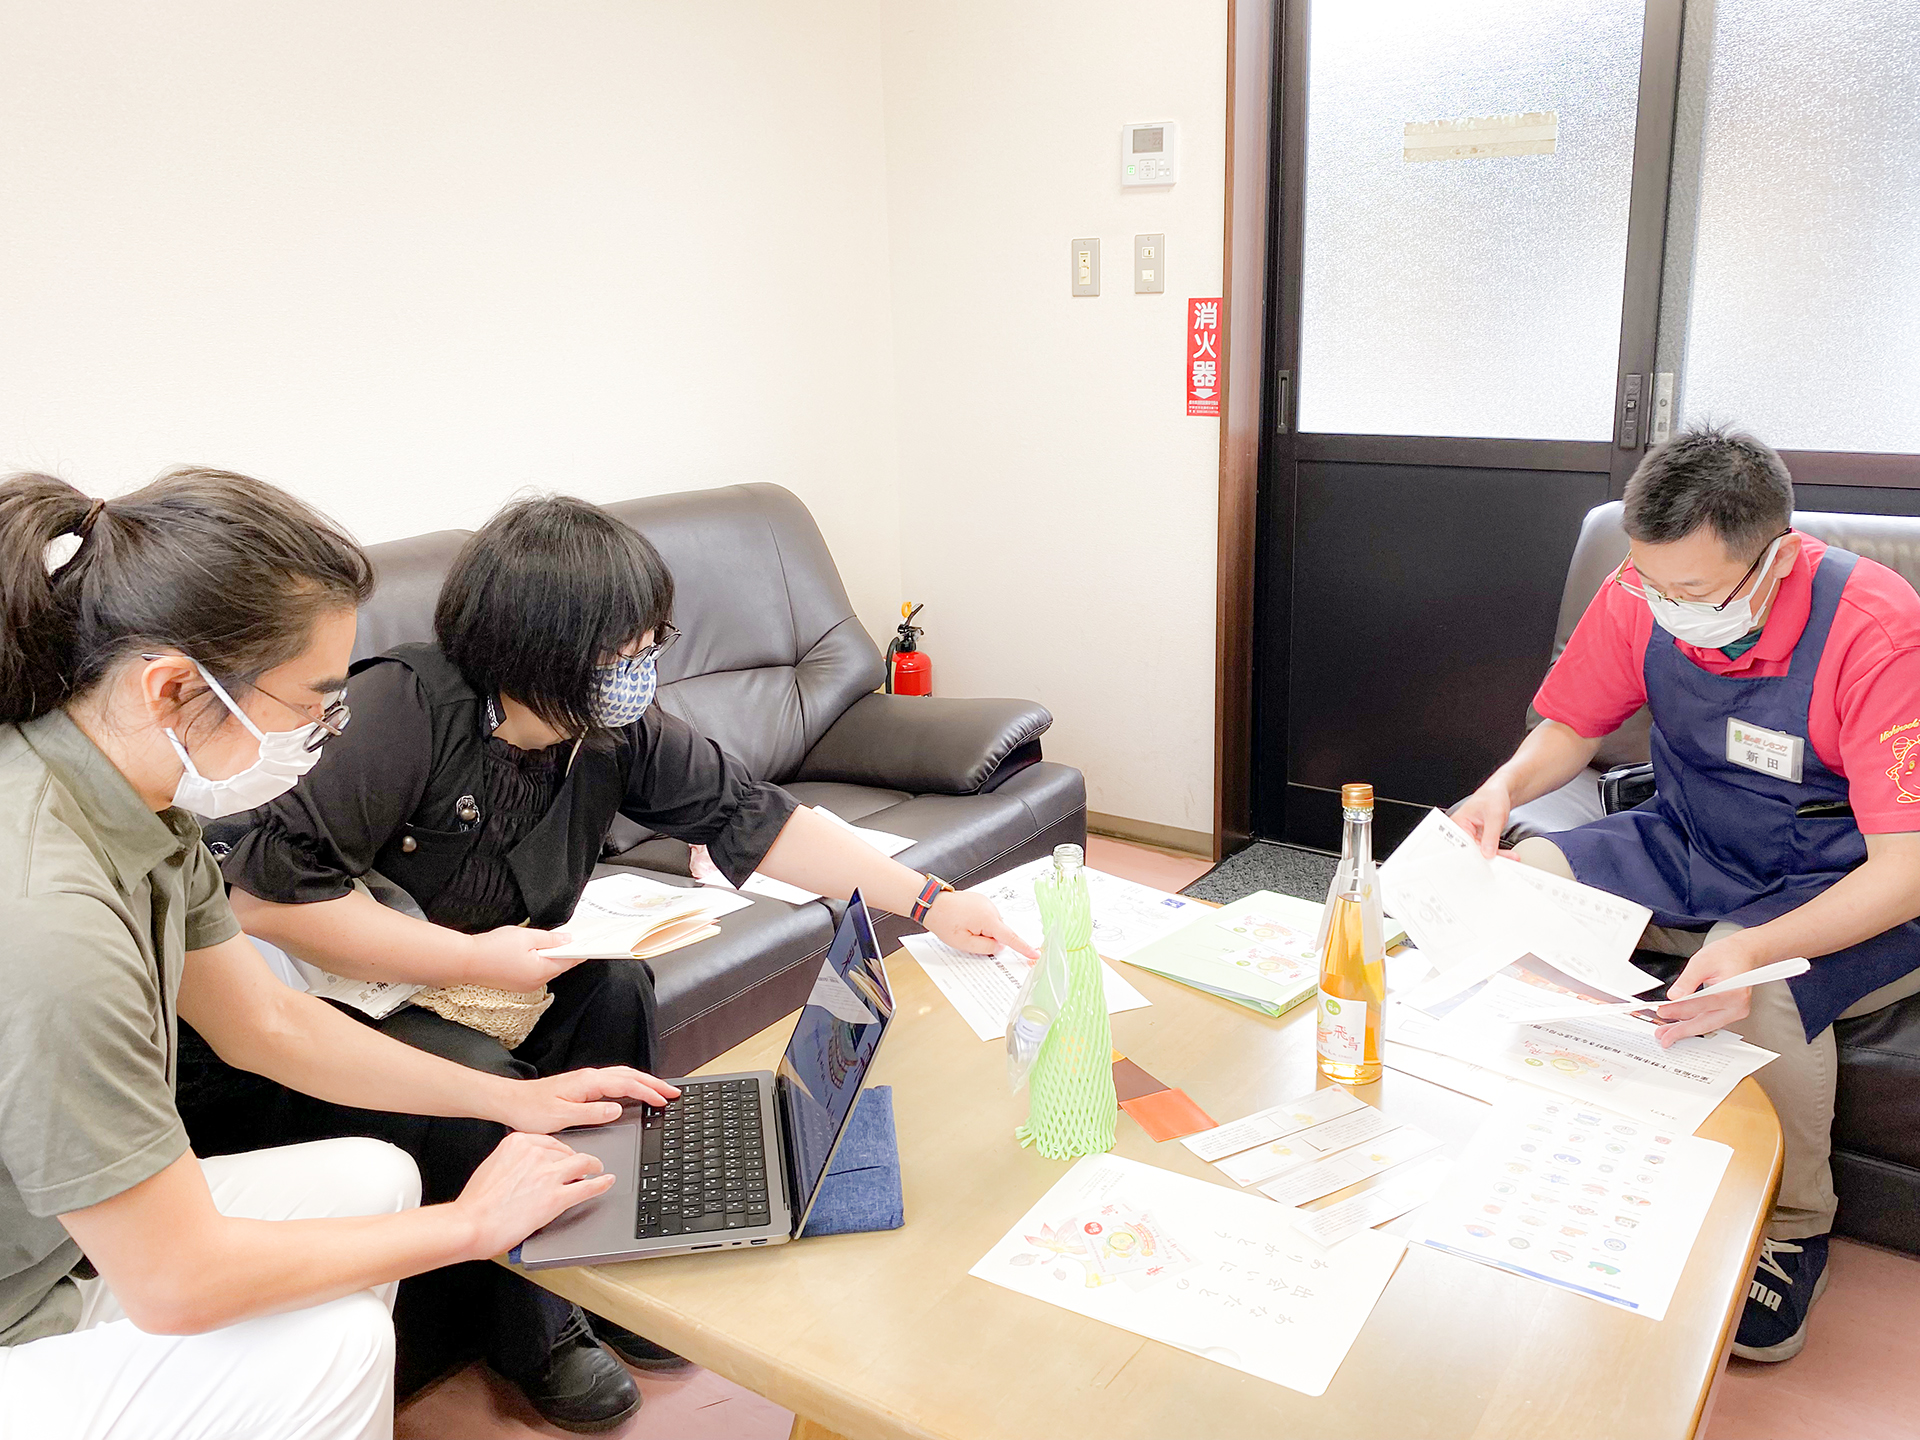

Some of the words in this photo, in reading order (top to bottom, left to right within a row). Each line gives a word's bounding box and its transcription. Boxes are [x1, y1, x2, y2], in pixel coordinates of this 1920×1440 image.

[1192, 301, 1217, 387] 消火器
[1214, 1230, 1329, 1270] ありがとう
[1176, 1278, 1295, 1325] あなたとの
[1219, 1261, 1315, 1299] 出会いに
